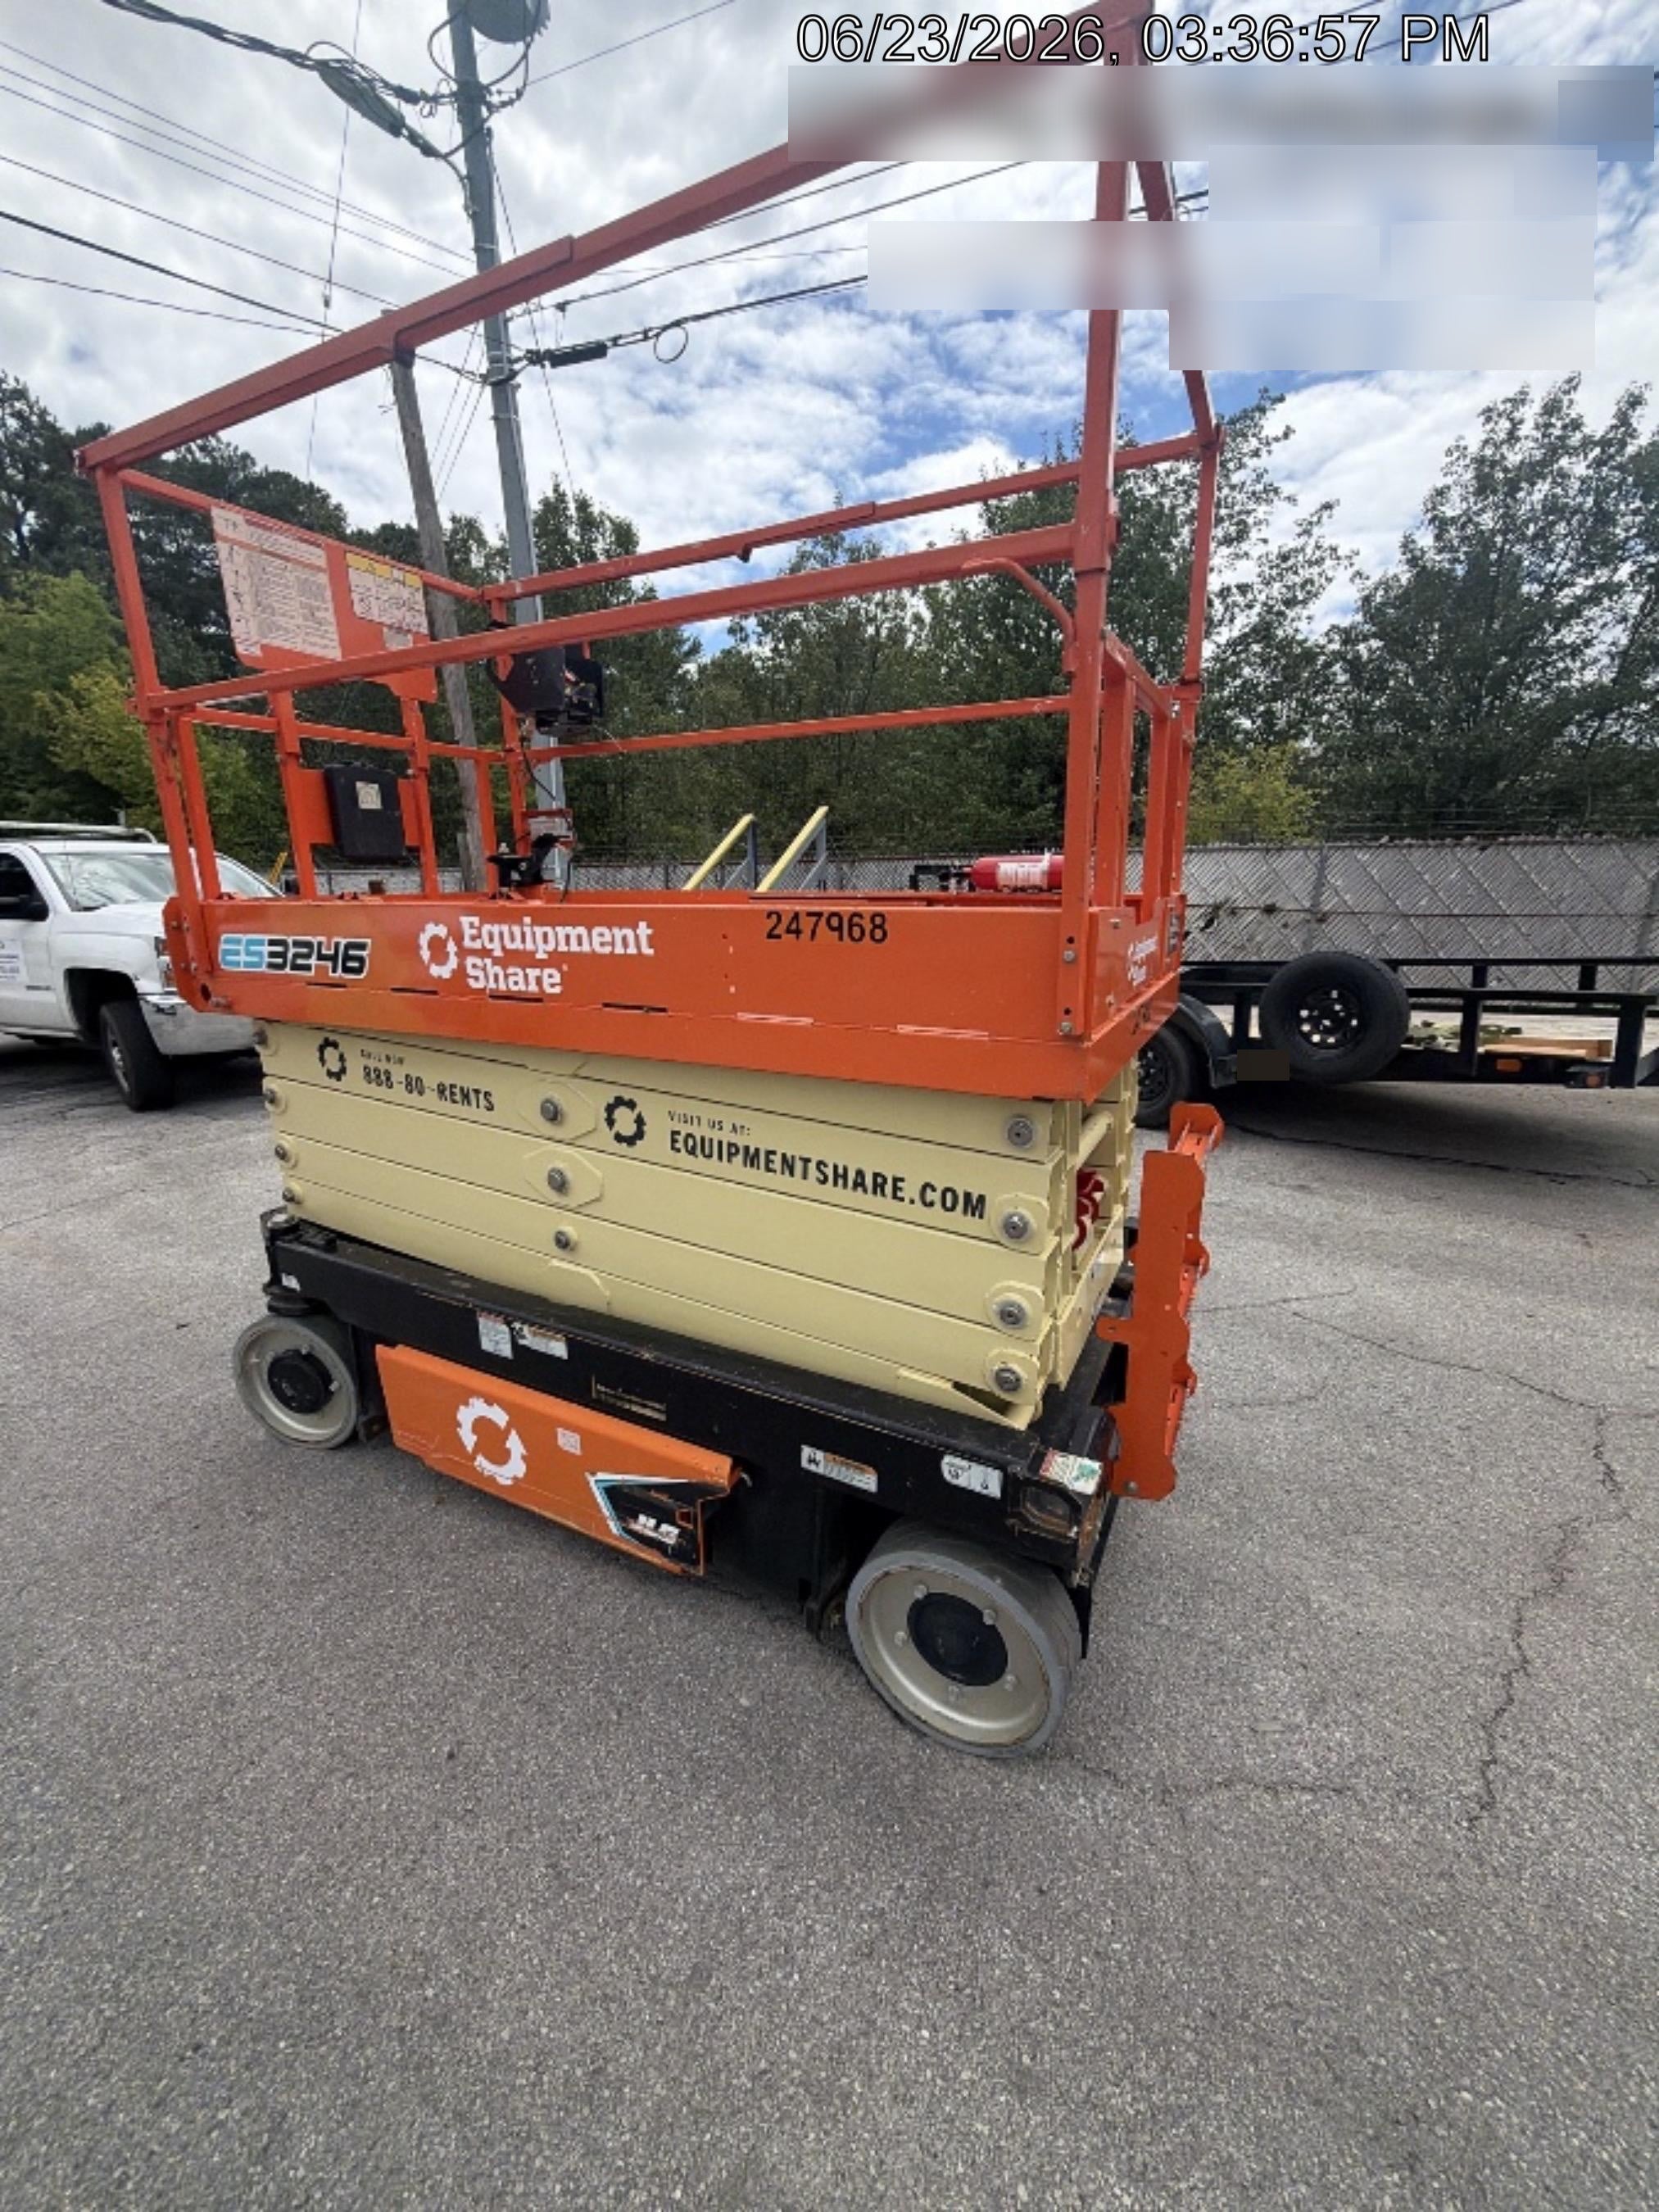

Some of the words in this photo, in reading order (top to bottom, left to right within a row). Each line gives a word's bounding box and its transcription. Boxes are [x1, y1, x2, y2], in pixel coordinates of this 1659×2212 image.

[459, 916, 655, 959] Equipment
[765, 911, 887, 943] 247968
[219, 934, 371, 979] ES3246
[465, 955, 562, 994] Share
[363, 1064, 495, 1112] 888-80-RENTS
[668, 1110, 701, 1127] VISIT
[708, 1118, 723, 1131] US
[669, 1130, 987, 1220] EQUIPMENTSHARE.COM
